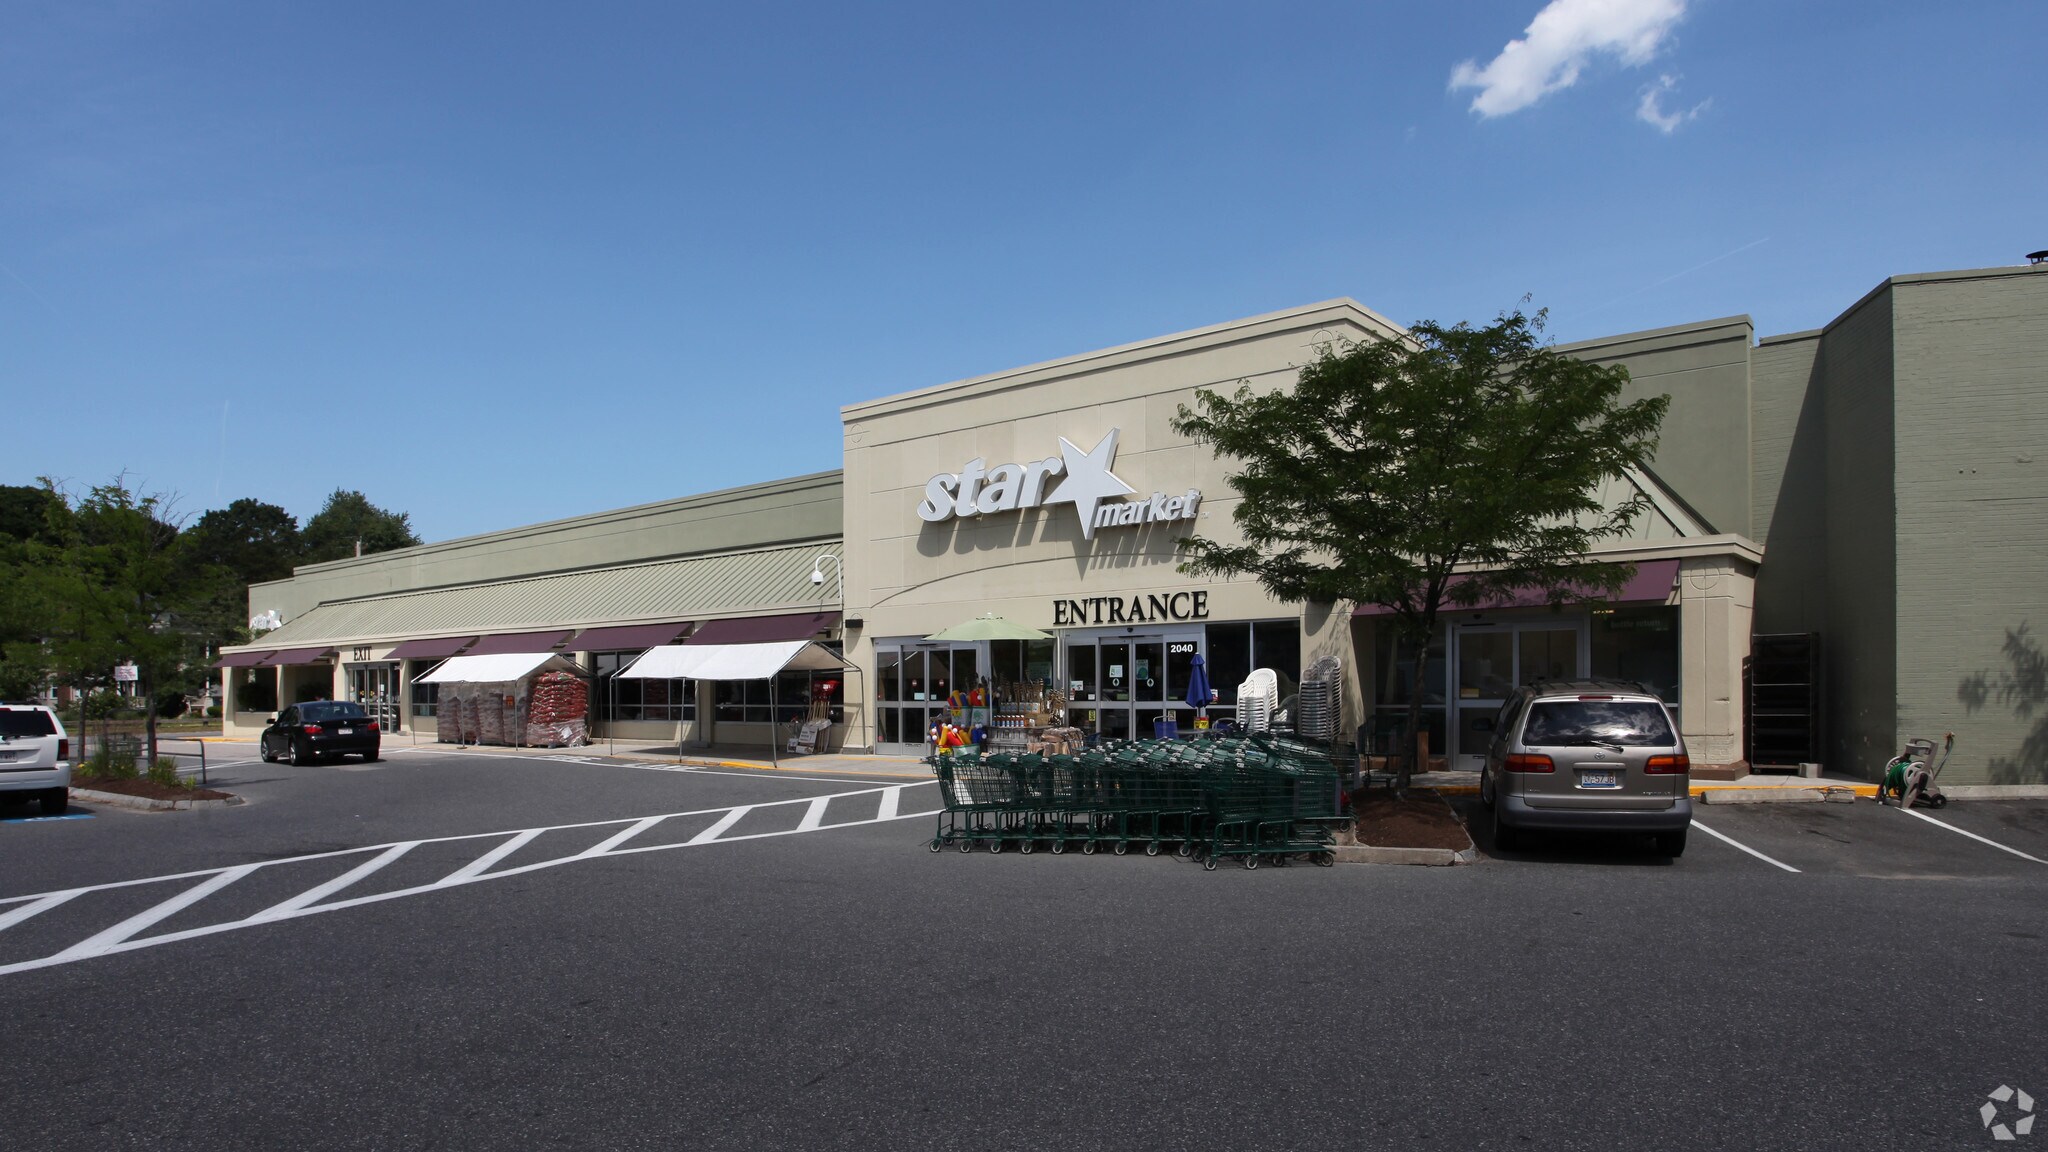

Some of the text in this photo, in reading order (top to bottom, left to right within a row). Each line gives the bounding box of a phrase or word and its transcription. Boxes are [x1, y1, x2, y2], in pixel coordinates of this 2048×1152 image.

[917, 456, 1067, 522] star
[1095, 488, 1202, 528] market
[1053, 591, 1210, 625] ENTRANCE
[354, 646, 372, 661] EXIT
[1170, 644, 1193, 653] 2040
